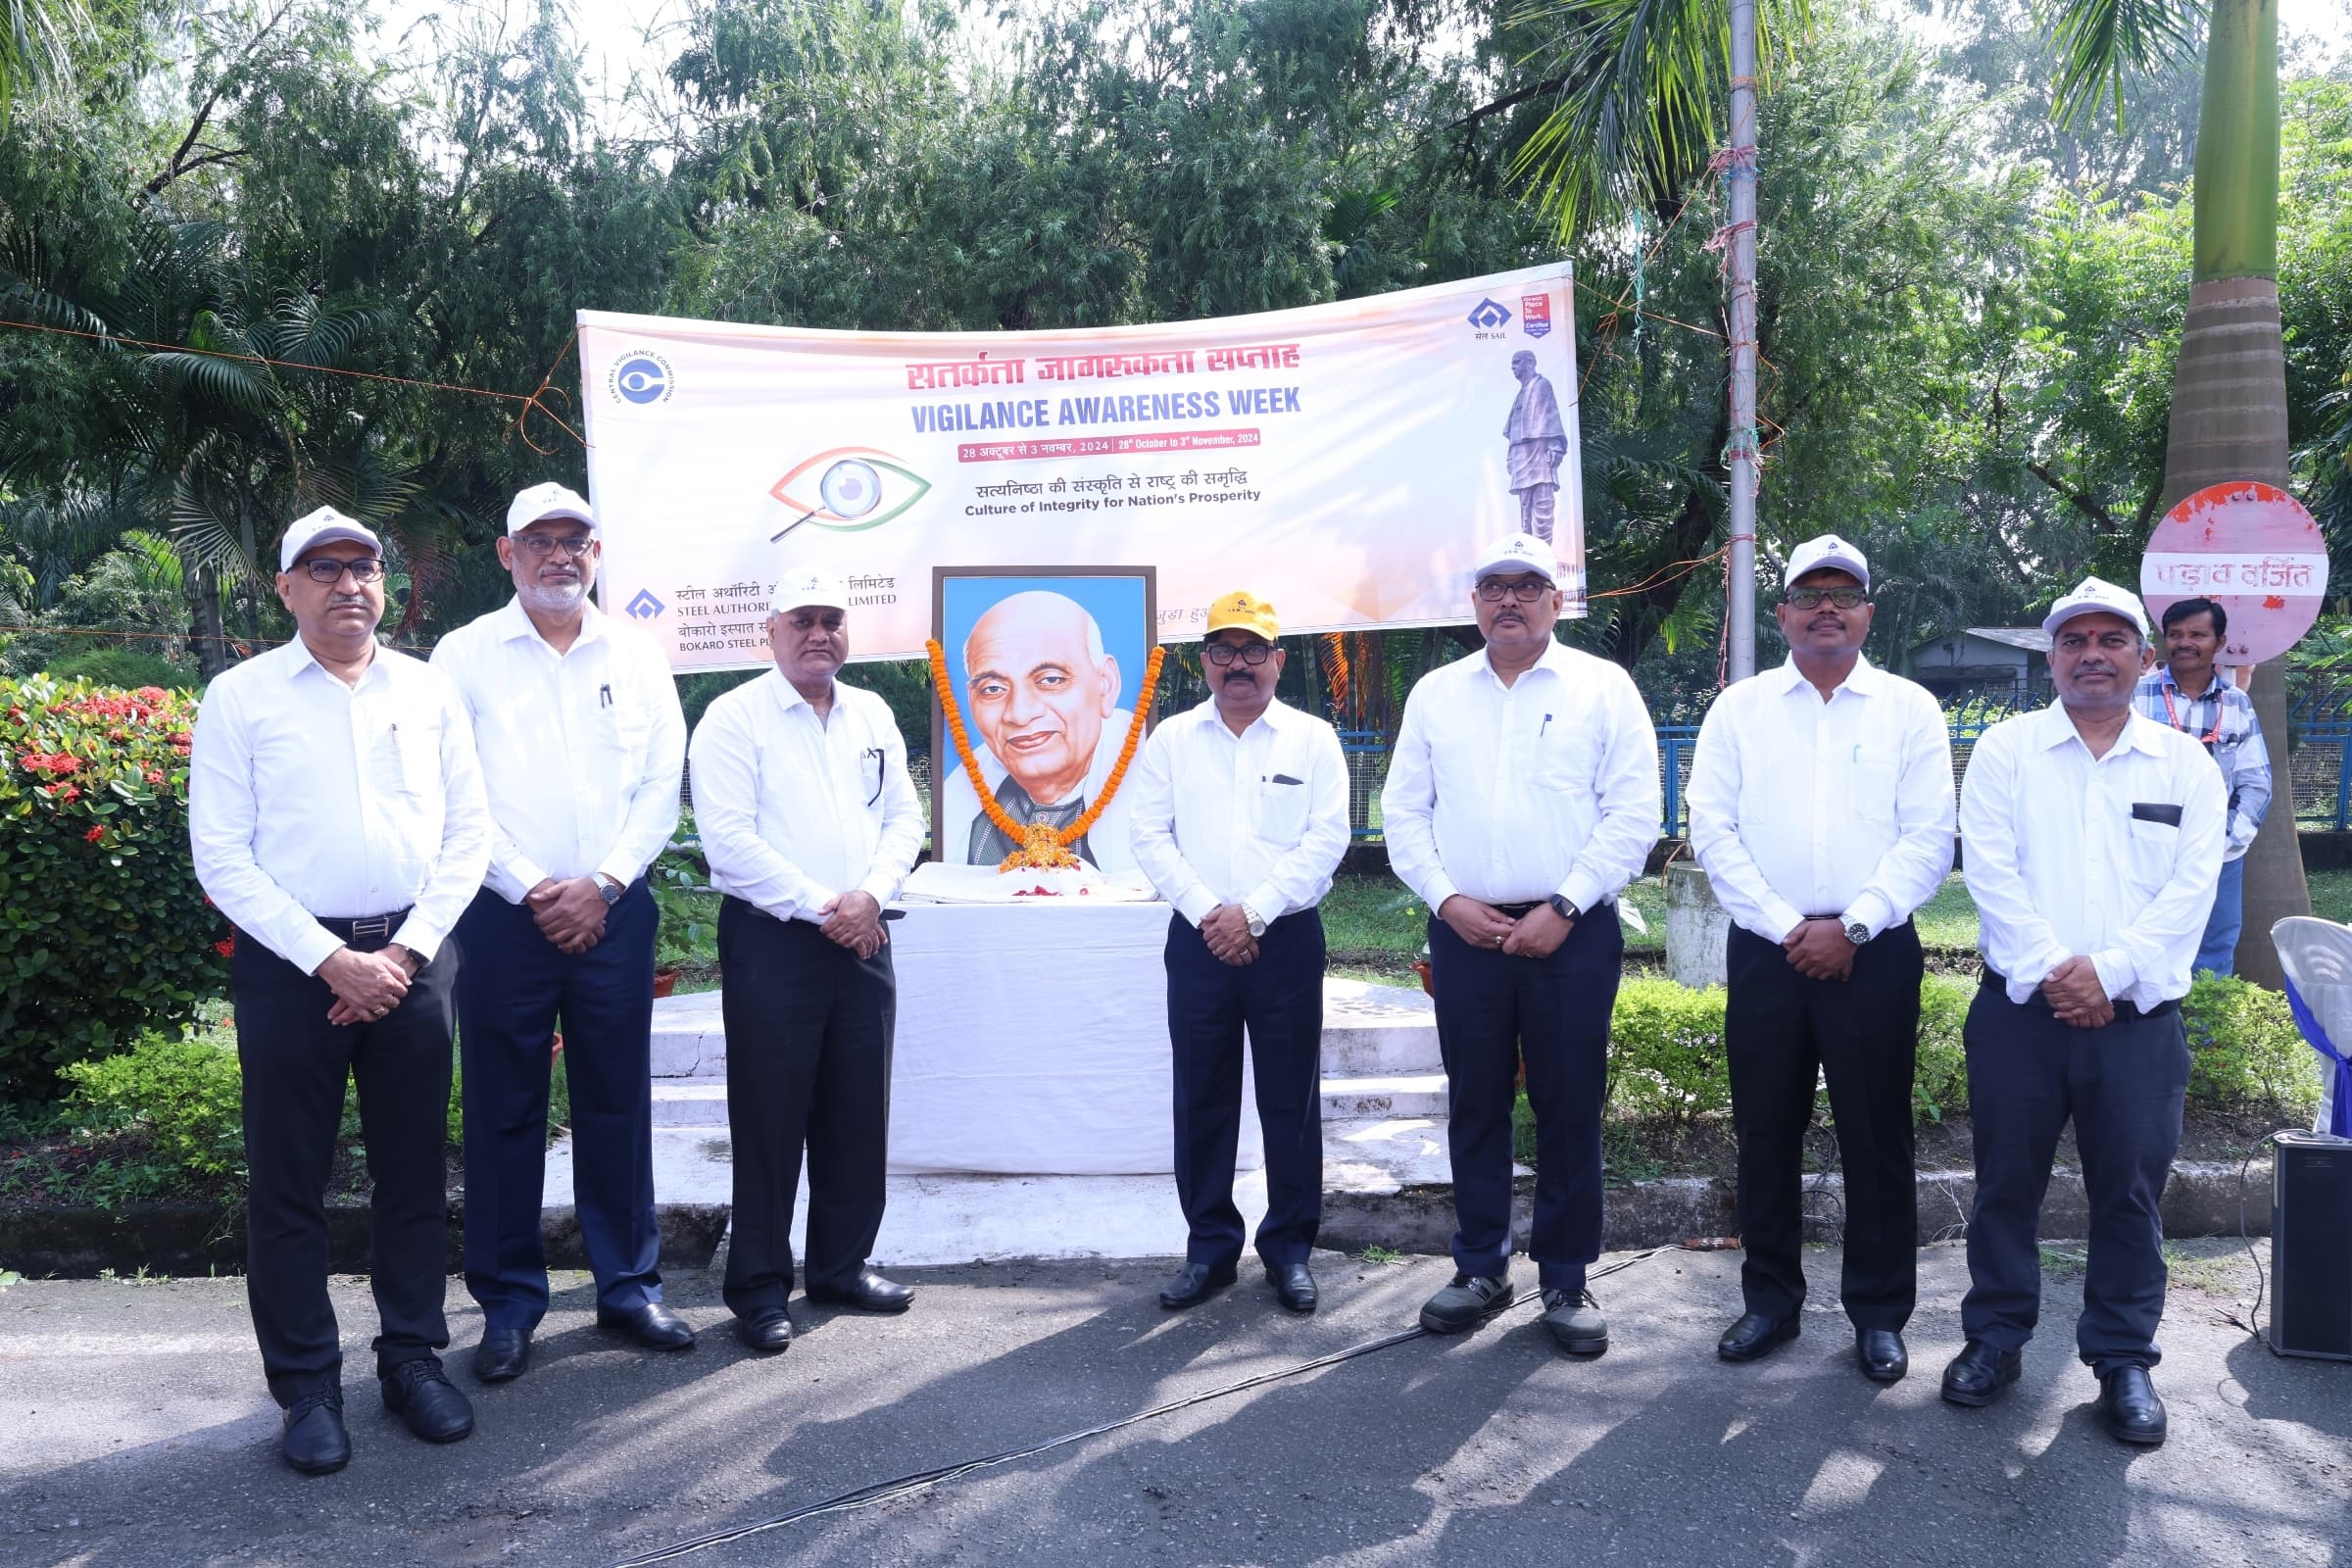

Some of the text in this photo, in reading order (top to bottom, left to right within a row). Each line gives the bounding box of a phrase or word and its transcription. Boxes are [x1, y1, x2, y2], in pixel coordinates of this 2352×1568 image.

[1490, 331, 1507, 340] SAIL
[608, 350, 675, 404] CENTRAL VIGILANCE COMMISSION
[906, 351, 1026, 390] सतर्कता
[1205, 343, 1300, 372] सप्ताह
[910, 386, 1301, 433] VIGILANCE AWARENESS WEEK
[962, 448, 976, 459] 28
[979, 445, 1015, 460] अक्टूबर
[1017, 442, 1027, 455] से
[1031, 444, 1038, 455] 3
[1080, 441, 1109, 452] 2024
[1135, 437, 1167, 449] October
[1170, 437, 1178, 447] to
[1238, 433, 1258, 444] 2024
[975, 466, 1248, 498] सत्यनिष्ठा की संस्कृति से राष्ट्र की समृद्धि
[965, 489, 1261, 516] Culture of Integrity for Nation's Prosperity
[2241, 556, 2316, 589] वर्जित
[675, 585, 706, 601] स्टील
[848, 573, 897, 590] लिमिटेड
[677, 594, 897, 617] STEEL AUTHORI LIMITED
[676, 620, 717, 638] बोकारो
[719, 622, 756, 637] इस्पात
[679, 640, 724, 652] BOKARO
[727, 638, 758, 649] STEEL
